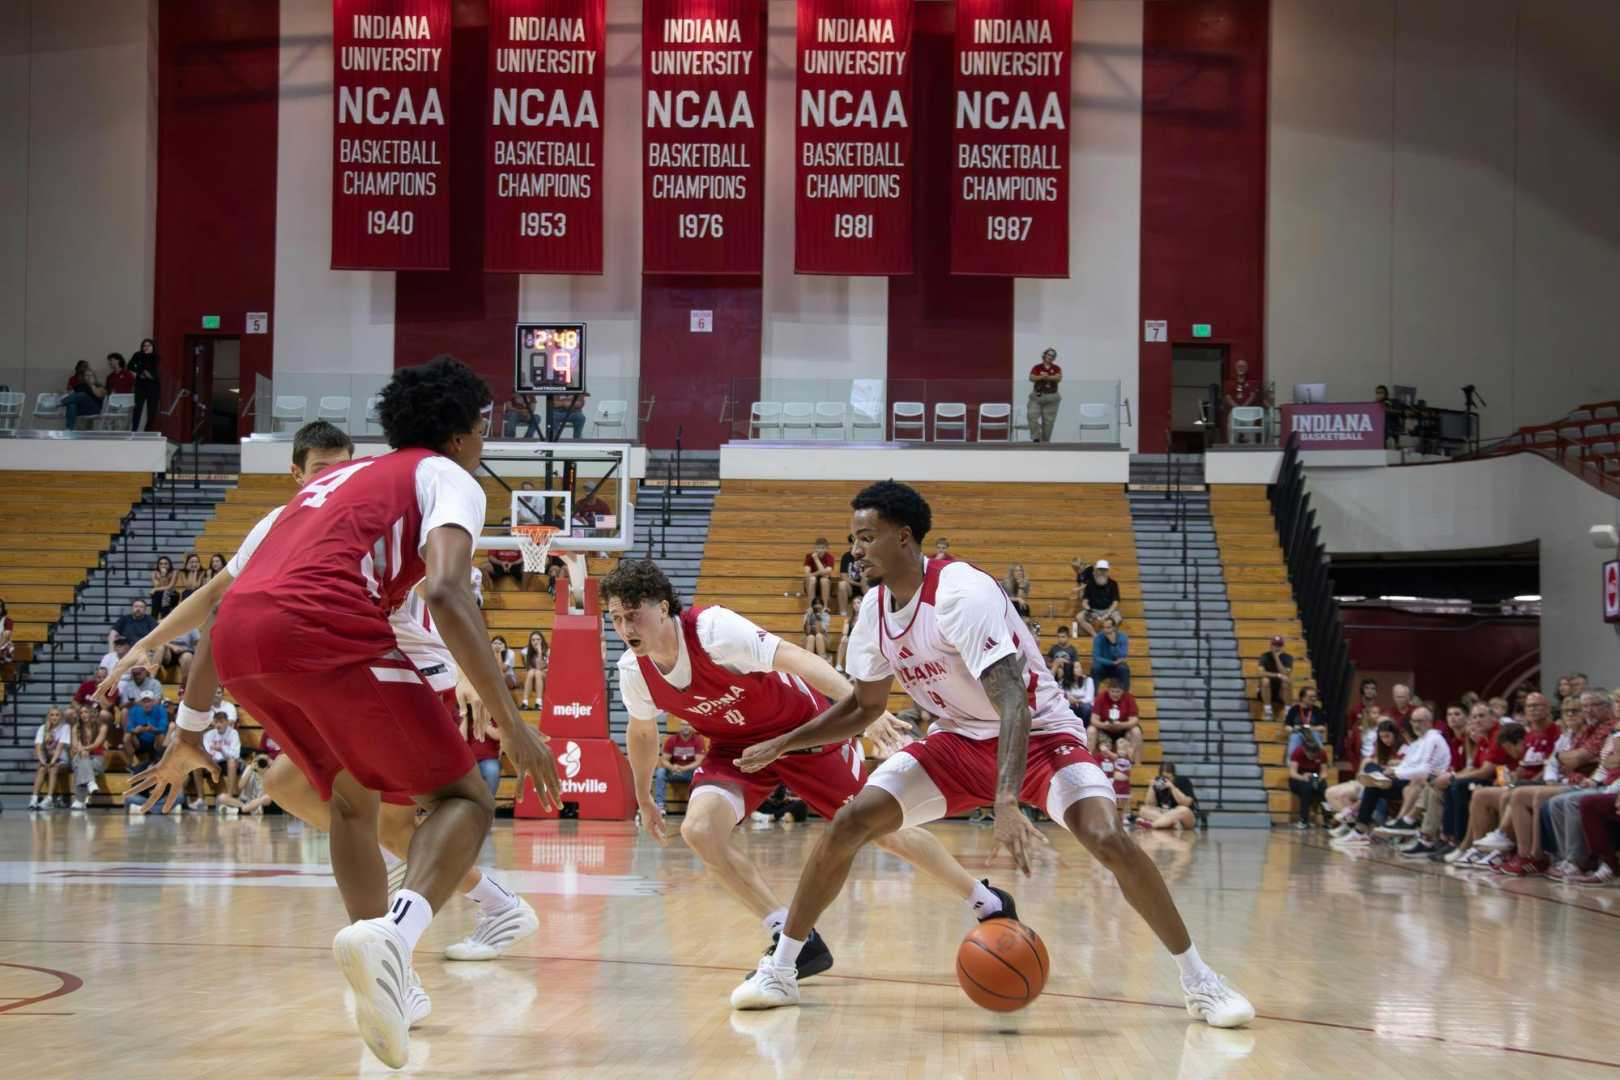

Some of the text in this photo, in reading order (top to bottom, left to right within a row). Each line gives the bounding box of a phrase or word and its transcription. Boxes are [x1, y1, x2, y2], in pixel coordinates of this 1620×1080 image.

[354, 15, 430, 39] INDIANA
[510, 17, 585, 41] INDIANA
[664, 19, 741, 43] INDIANA
[818, 19, 895, 43] INDIANA
[974, 19, 1052, 43] INDIANA
[342, 47, 441, 71] UNIVERSITY
[497, 49, 596, 74] UNIVERSITY
[651, 51, 752, 75] UNIVERSITY
[805, 50, 905, 75] UNIVERSITY
[961, 52, 1063, 76] UNIVERSITY
[339, 87, 445, 125] NCAA
[493, 88, 599, 128] NCAA
[647, 91, 754, 128] NCAA
[801, 90, 908, 128] NCAA
[956, 91, 1065, 129] NCAA
[341, 140, 440, 165] BASKETBALL
[495, 141, 595, 167] BASKETBALL
[649, 143, 750, 168] BASKETBALL
[803, 143, 904, 167] BASKETBALL
[959, 144, 1061, 169] BASKETBALL
[344, 172, 436, 195] CHAMPIONS
[499, 174, 591, 198] CHAMPIONS
[653, 175, 746, 199] CHAMPIONS
[807, 175, 900, 199] CHAMPIONS
[963, 177, 1057, 201] CHAMPIONS
[368, 211, 413, 234] 1940
[521, 213, 566, 236] 1953
[680, 214, 723, 238] 1976
[835, 214, 873, 238] 1981
[987, 217, 1032, 240] 1987
[253, 319, 261, 332] 5
[1152, 327, 1160, 339] 7
[552, 352, 571, 383] 9
[1291, 414, 1374, 432] INDIANA
[298, 461, 375, 508] 4
[553, 702, 593, 719] meijer
[559, 779, 608, 794] thville
